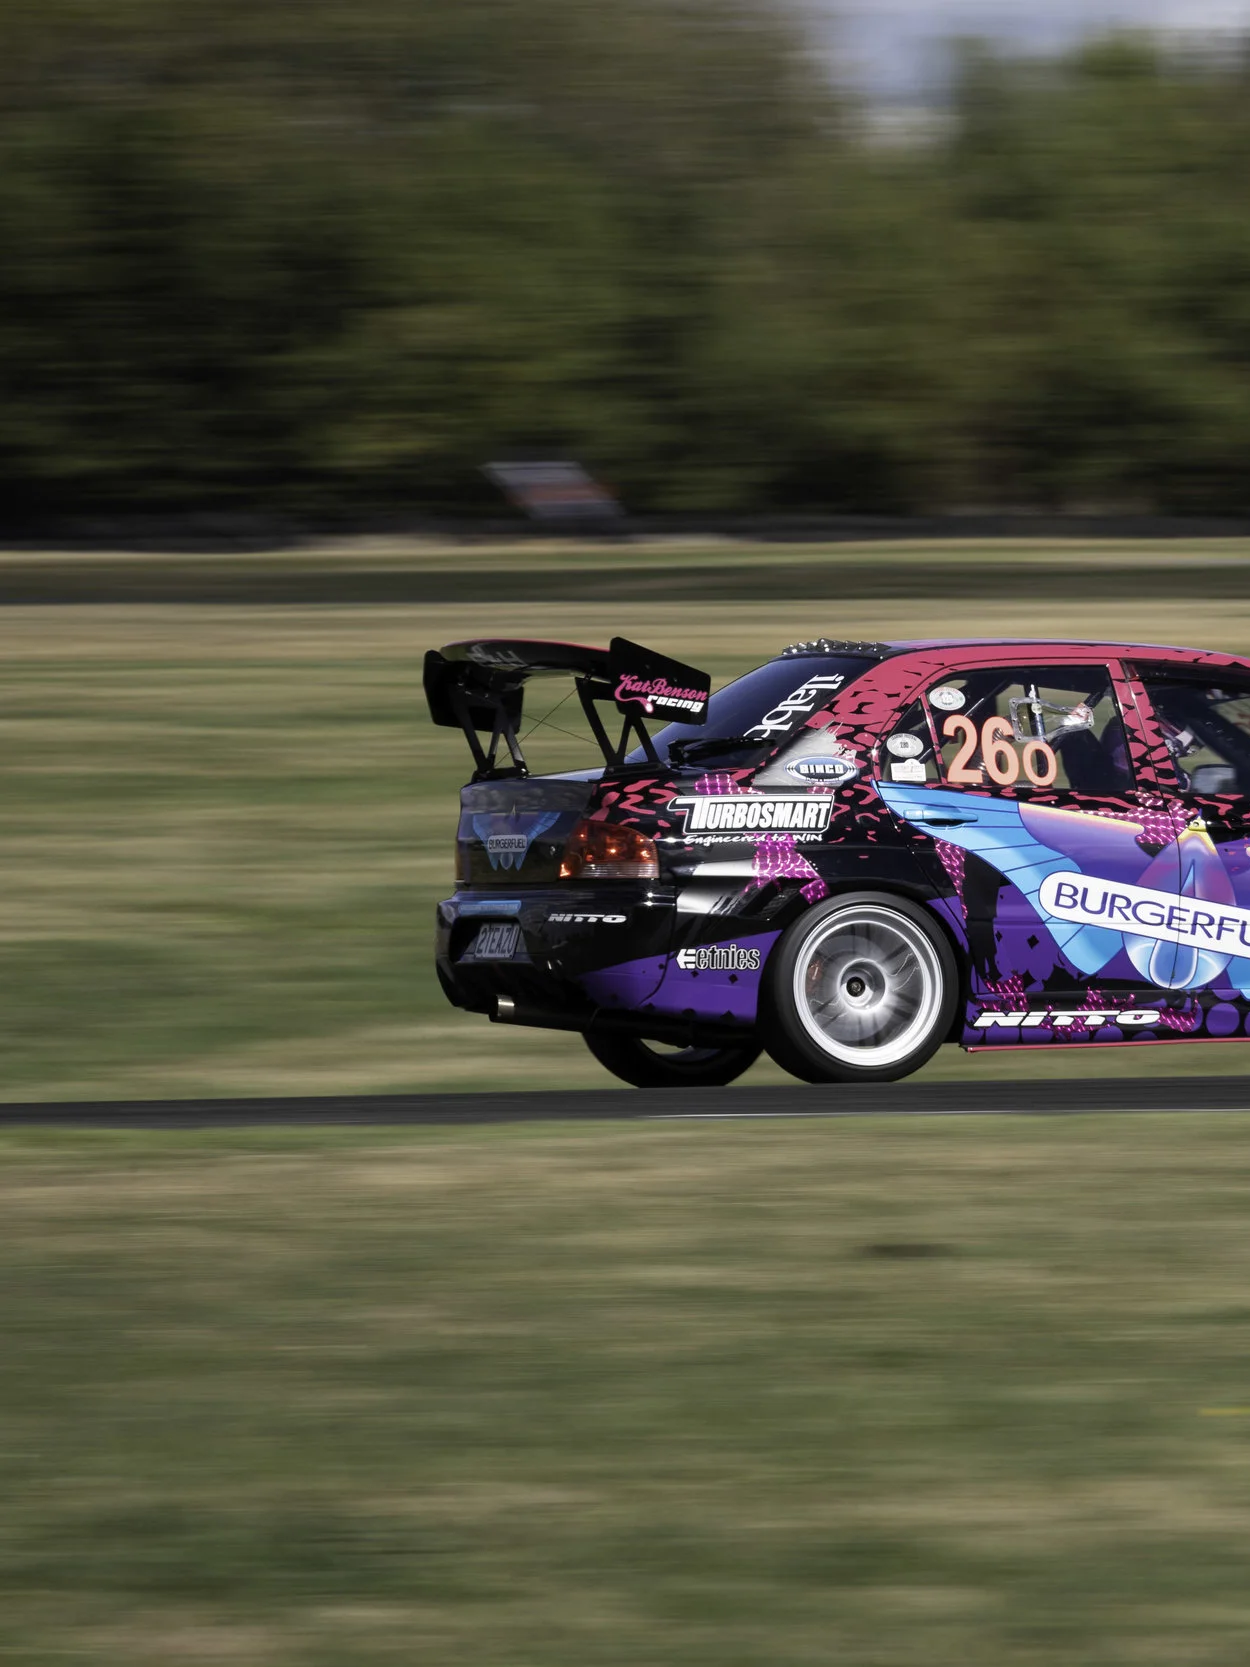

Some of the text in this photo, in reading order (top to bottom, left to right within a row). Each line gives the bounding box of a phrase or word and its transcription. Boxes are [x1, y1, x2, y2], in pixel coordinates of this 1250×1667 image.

[647, 694, 704, 713] racing
[675, 796, 833, 830] TURBOSMART
[488, 838, 527, 850] BURGERFUEL
[684, 834, 823, 847] Engineered to WIN
[548, 913, 627, 924] NITTO
[695, 944, 761, 971] etnies
[973, 1009, 1161, 1027] NITTO
